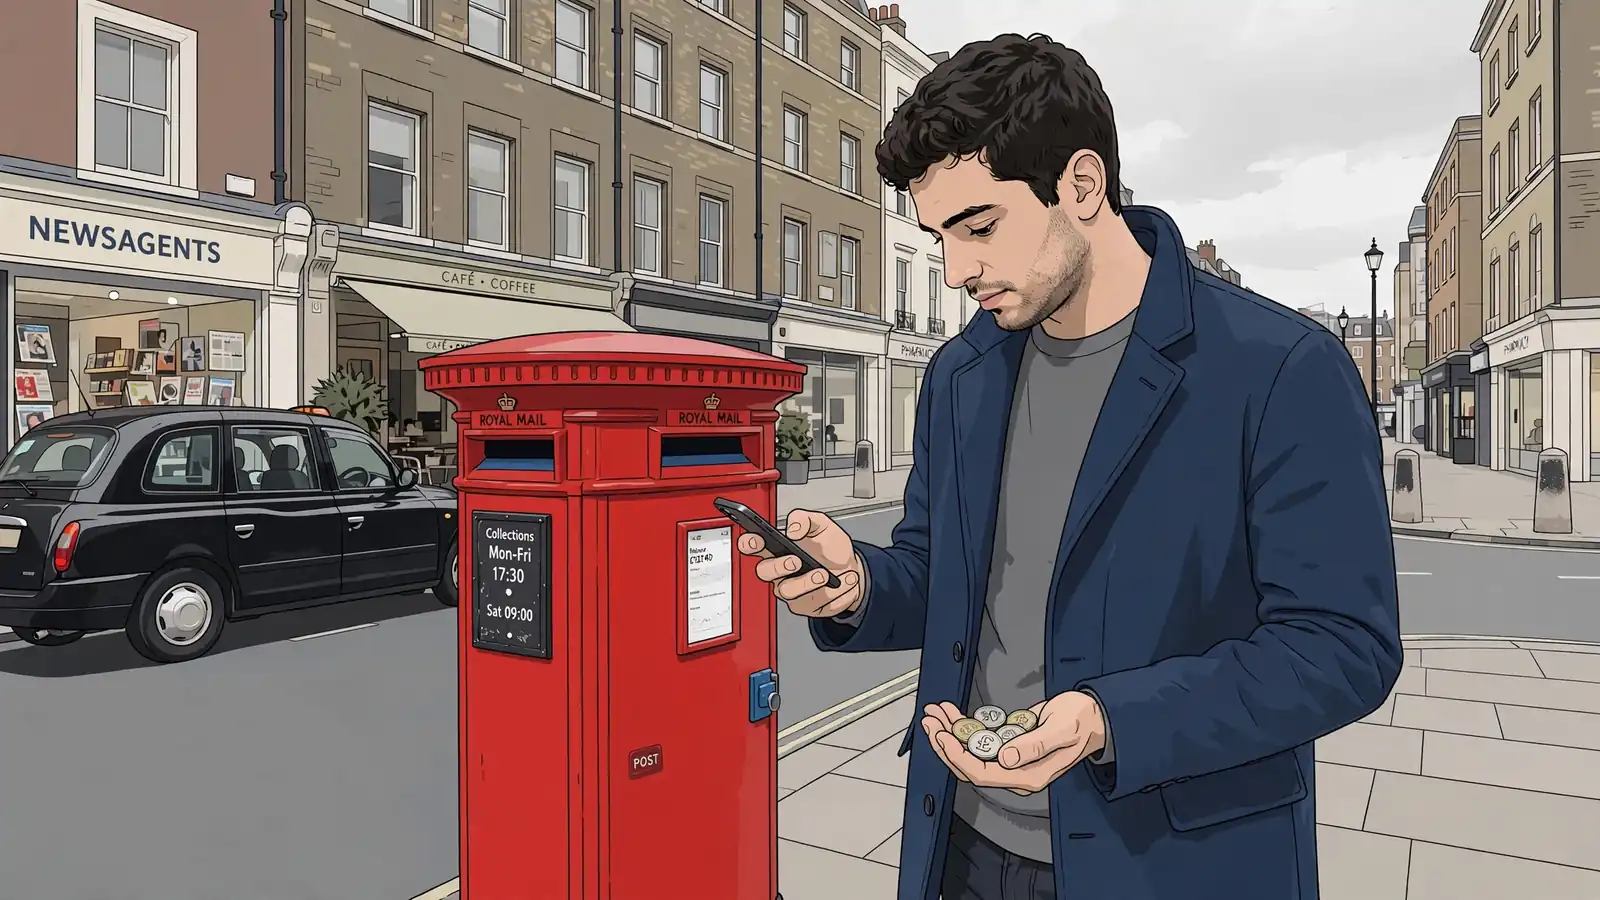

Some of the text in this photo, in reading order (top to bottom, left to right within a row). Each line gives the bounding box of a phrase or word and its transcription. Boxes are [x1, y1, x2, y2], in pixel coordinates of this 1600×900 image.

[29, 215, 221, 264] NEWSAGENTS
[441, 270, 536, 294] CAFÉ COFFEE
[480, 413, 547, 426] ROYAL MAIL
[679, 411, 743, 424] ROYAL MAIL
[485, 527, 535, 542] Collections
[488, 545, 532, 563] Mon-Fri
[492, 566, 525, 583] 17:30
[486, 603, 533, 622] Sat 09:00
[633, 753, 659, 769] POST
